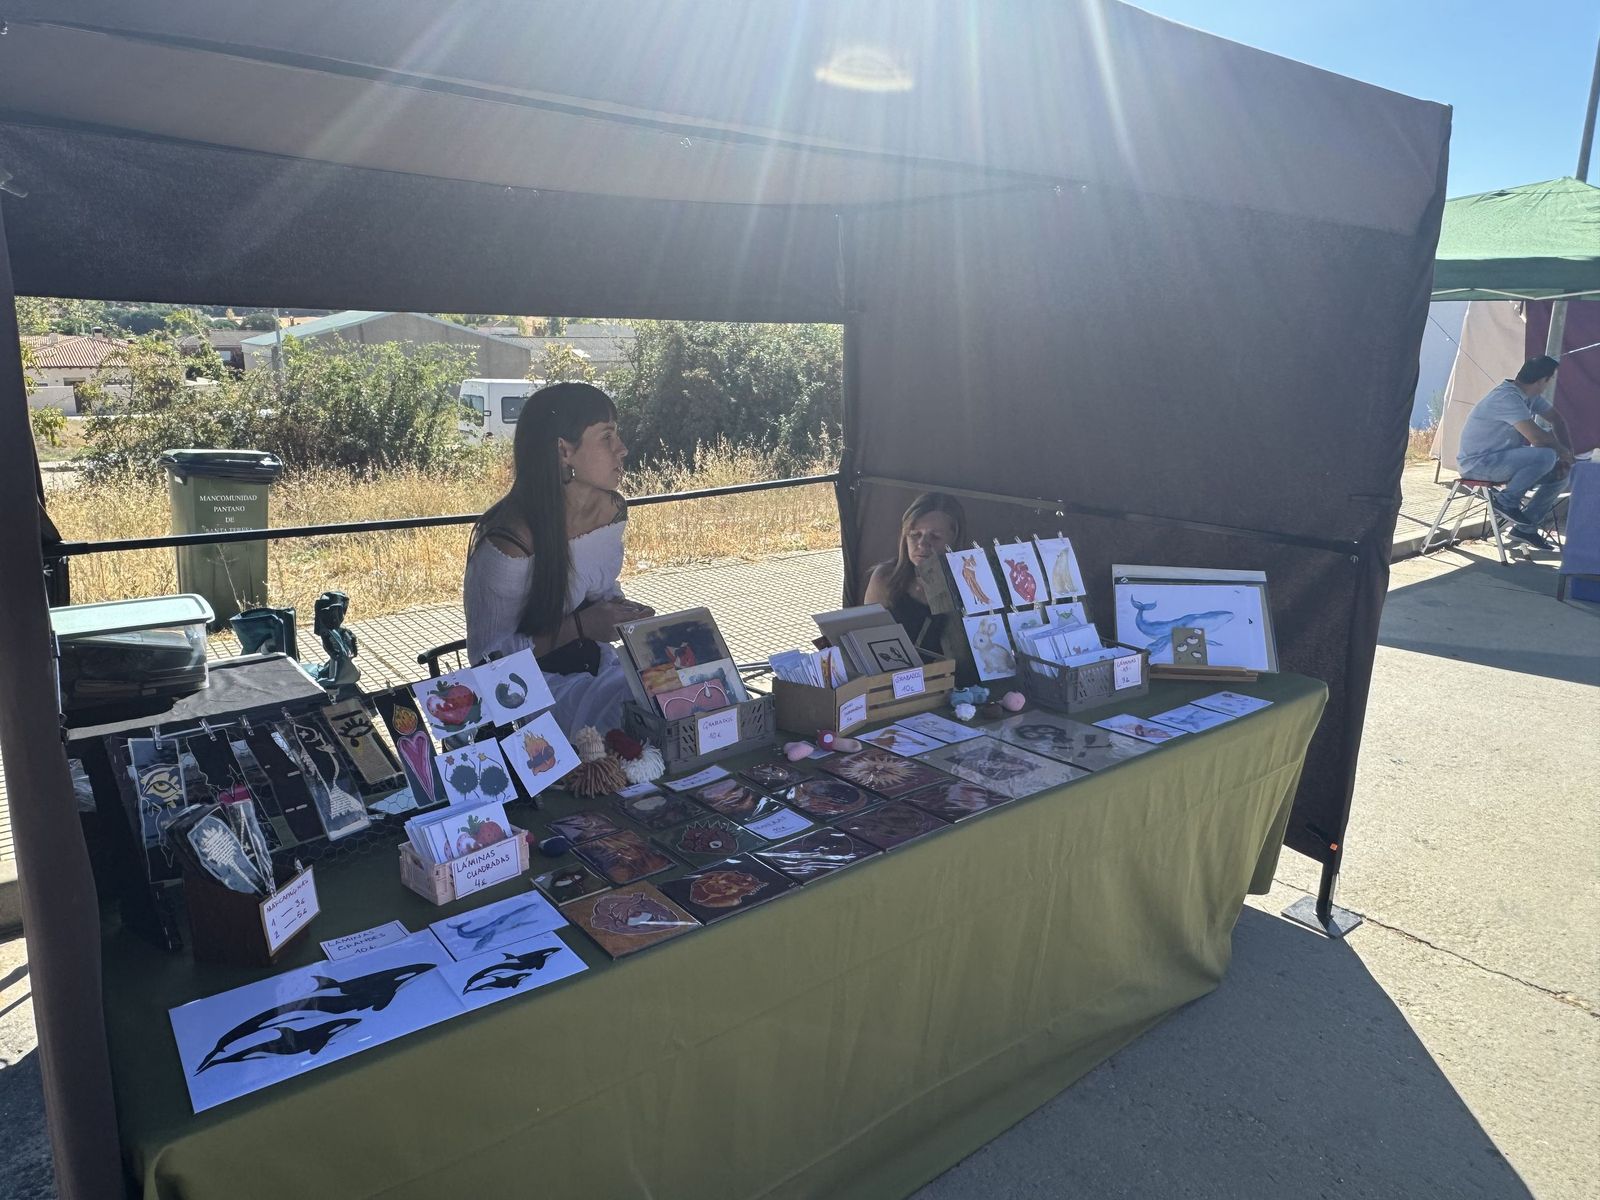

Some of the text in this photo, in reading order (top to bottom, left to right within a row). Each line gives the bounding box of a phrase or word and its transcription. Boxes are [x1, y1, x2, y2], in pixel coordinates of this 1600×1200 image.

[456, 849, 496, 873] LÁMINAS
[466, 854, 510, 879] CUADRADAS
[273, 930, 280, 939] 2
[337, 932, 386, 951] GRANDES
